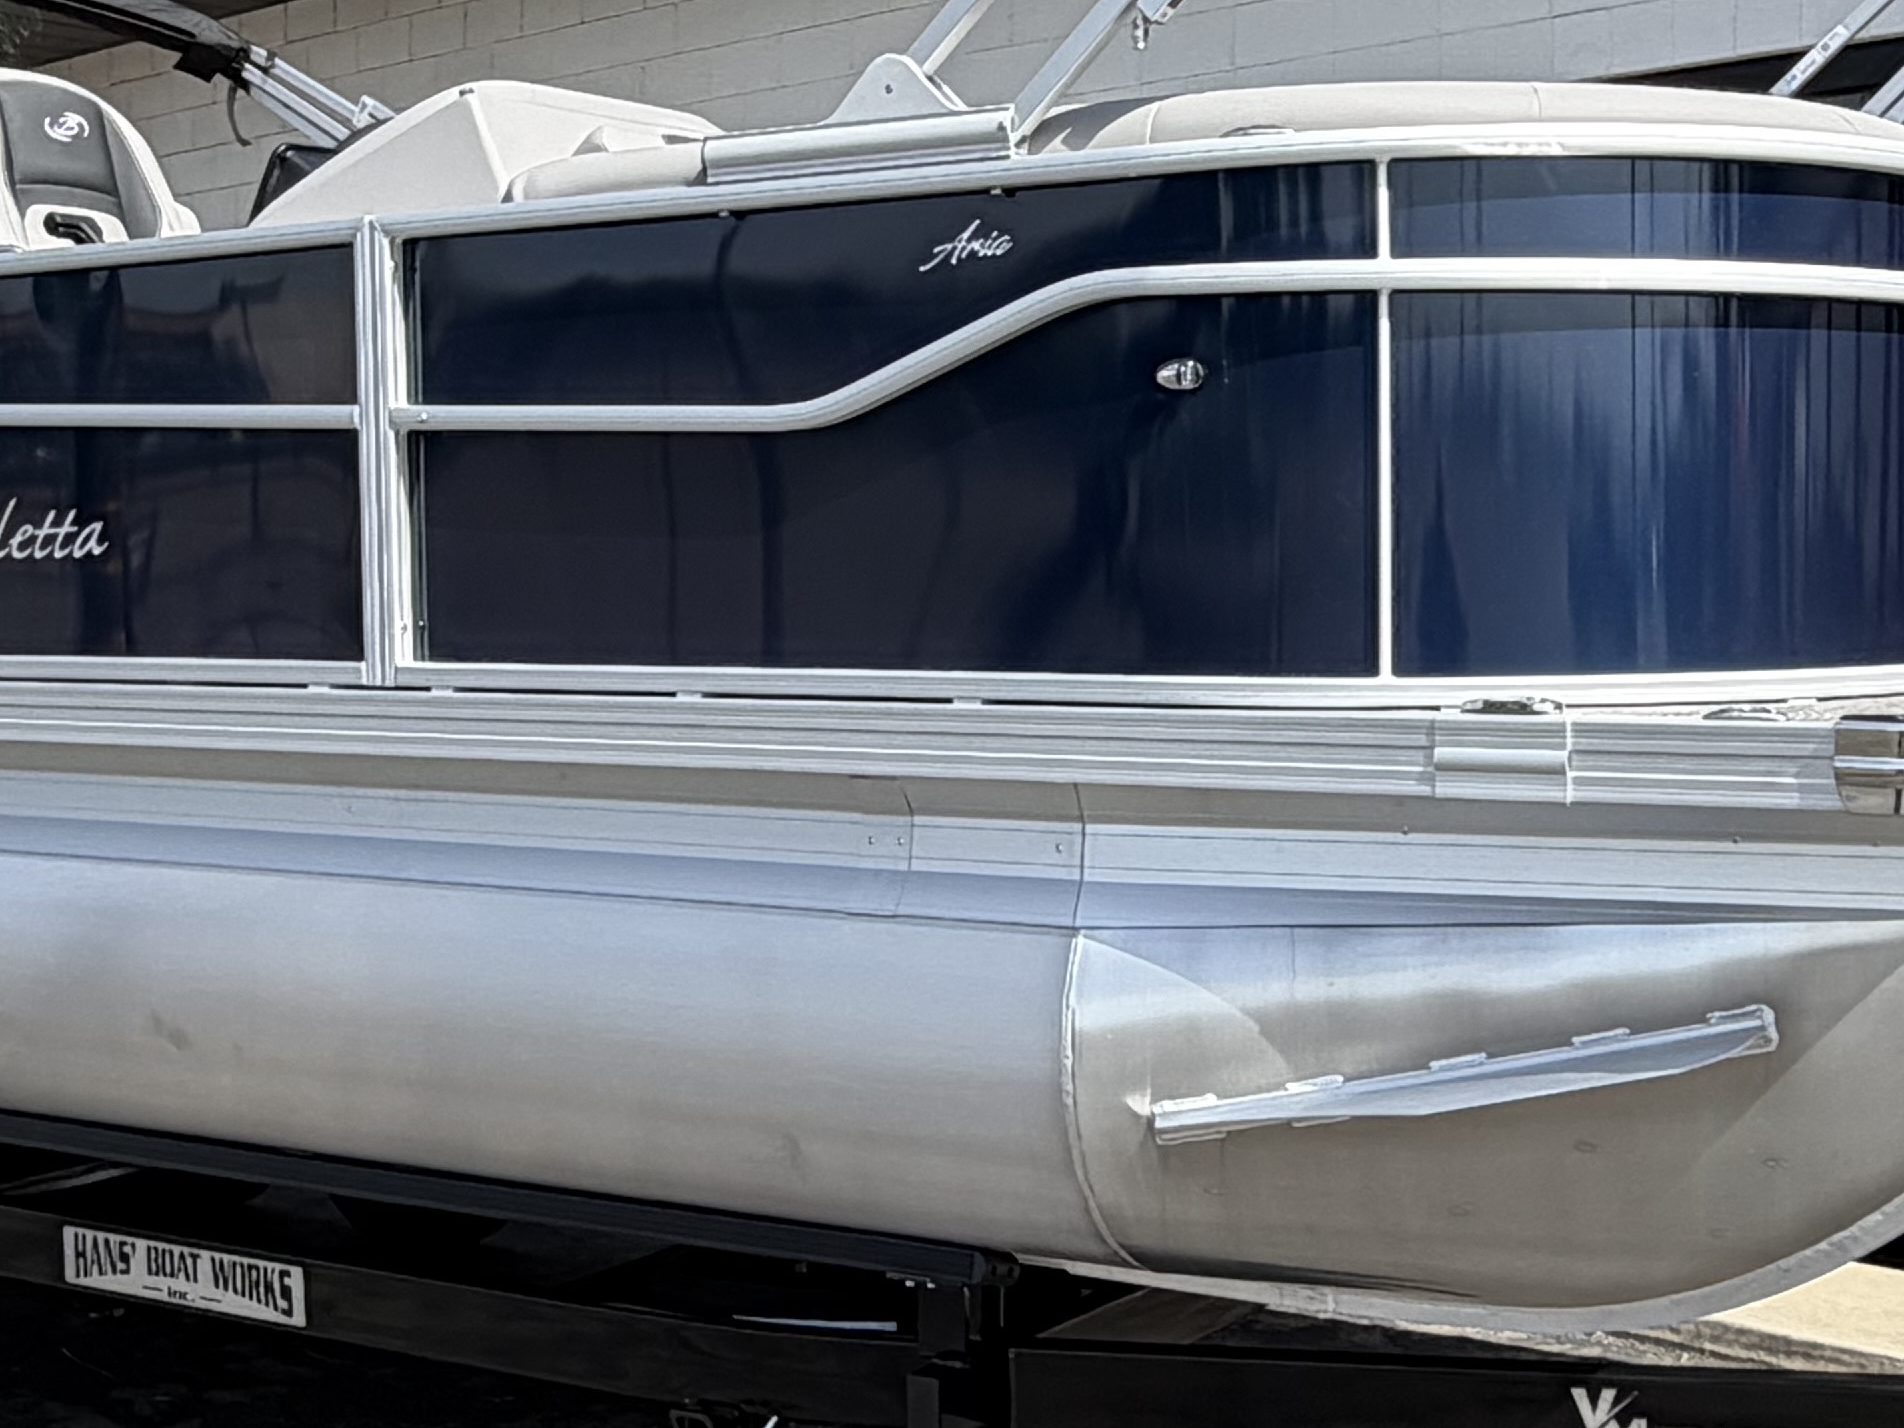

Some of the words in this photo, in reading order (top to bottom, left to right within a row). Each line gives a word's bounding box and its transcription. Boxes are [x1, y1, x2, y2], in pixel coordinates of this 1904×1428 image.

[918, 218, 1014, 272] Aria
[73, 1230, 137, 1279] HANS'
[146, 1244, 202, 1285] BOAT
[210, 1255, 294, 1319] WORKS
